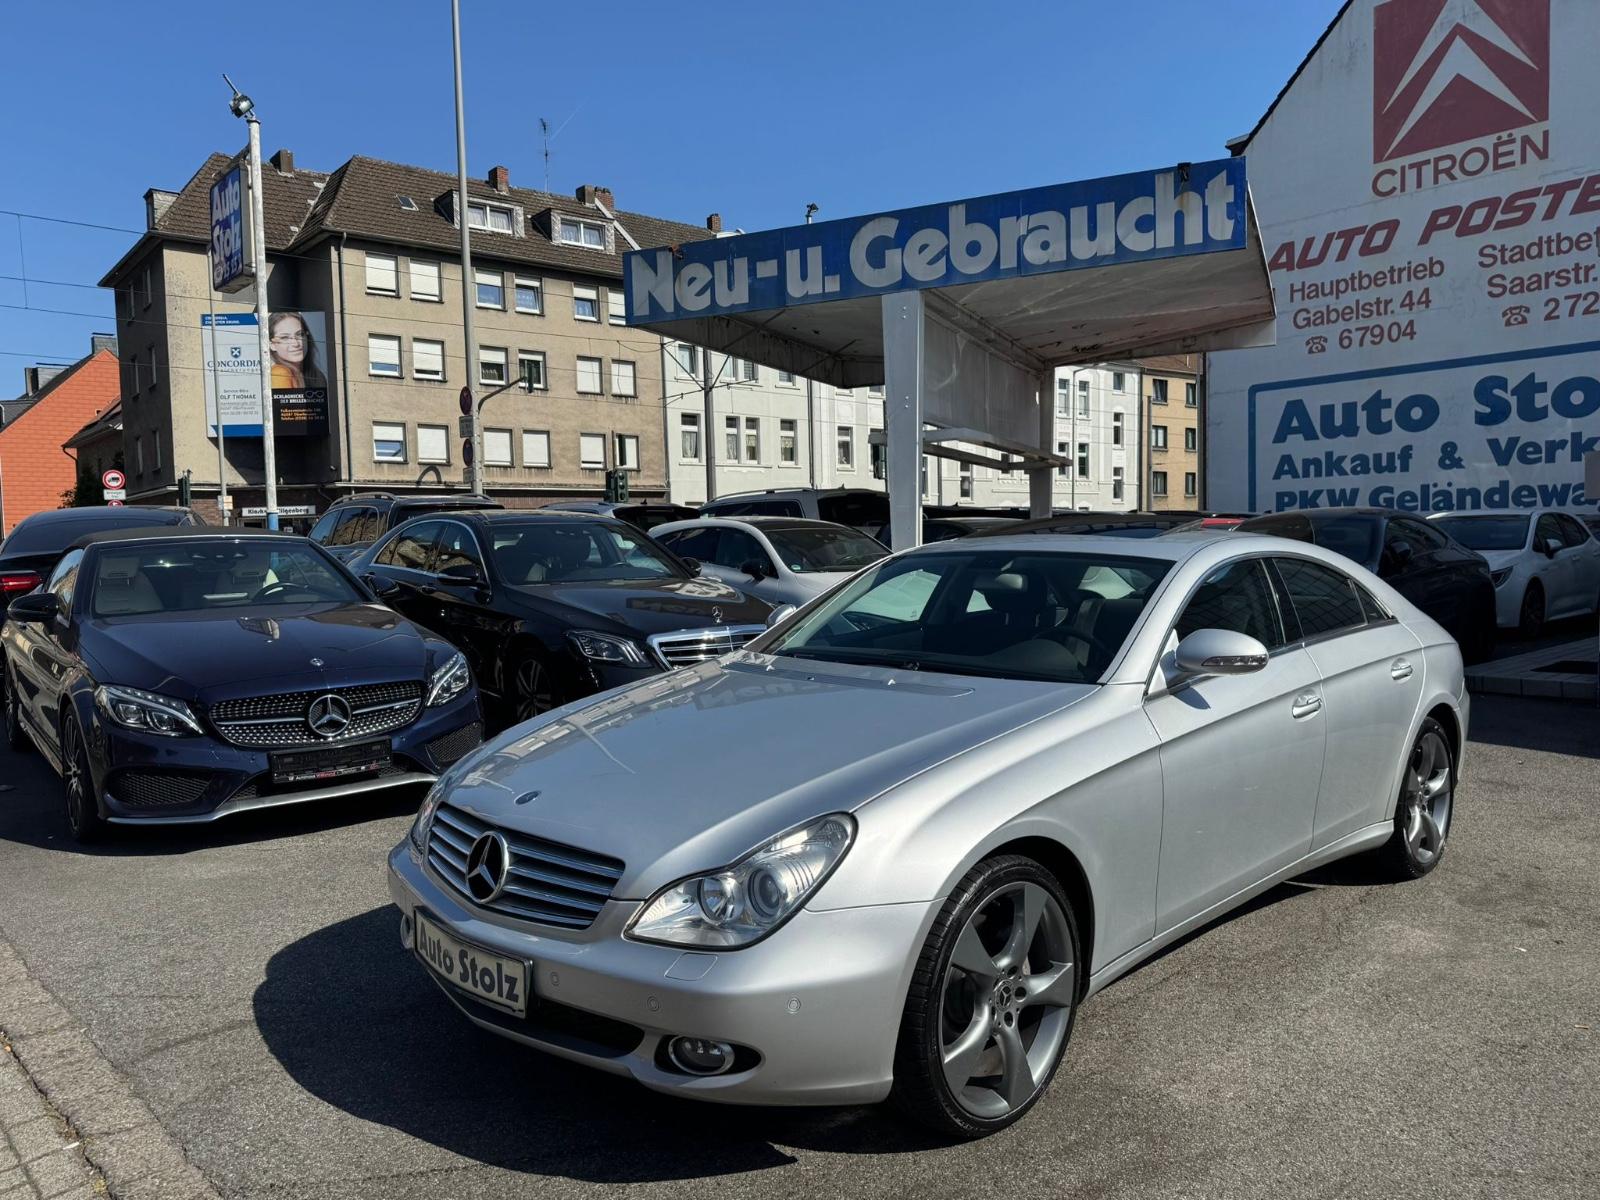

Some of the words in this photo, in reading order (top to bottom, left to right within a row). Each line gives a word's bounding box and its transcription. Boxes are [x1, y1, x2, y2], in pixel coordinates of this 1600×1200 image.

[1371, 129, 1549, 197] CITROËN
[212, 178, 240, 224] Auto
[212, 215, 241, 264] Stolz
[849, 169, 1236, 288] Gebraucht
[1269, 219, 1400, 272] AUTO
[1290, 256, 1444, 303] Hauptbetrieb
[1487, 261, 1597, 298] Saarstr.
[1292, 297, 1395, 330] Gabelstr.
[1399, 288, 1432, 312] 44
[1338, 319, 1417, 349] 67904
[1272, 389, 1440, 444] Auto
[1473, 371, 1600, 427] Sto
[1272, 444, 1413, 480] Ankauf
[1438, 440, 1465, 470] &
[1275, 487, 1360, 512] PKW
[419, 921, 454, 975] Auto
[458, 949, 519, 1003] Stolz
